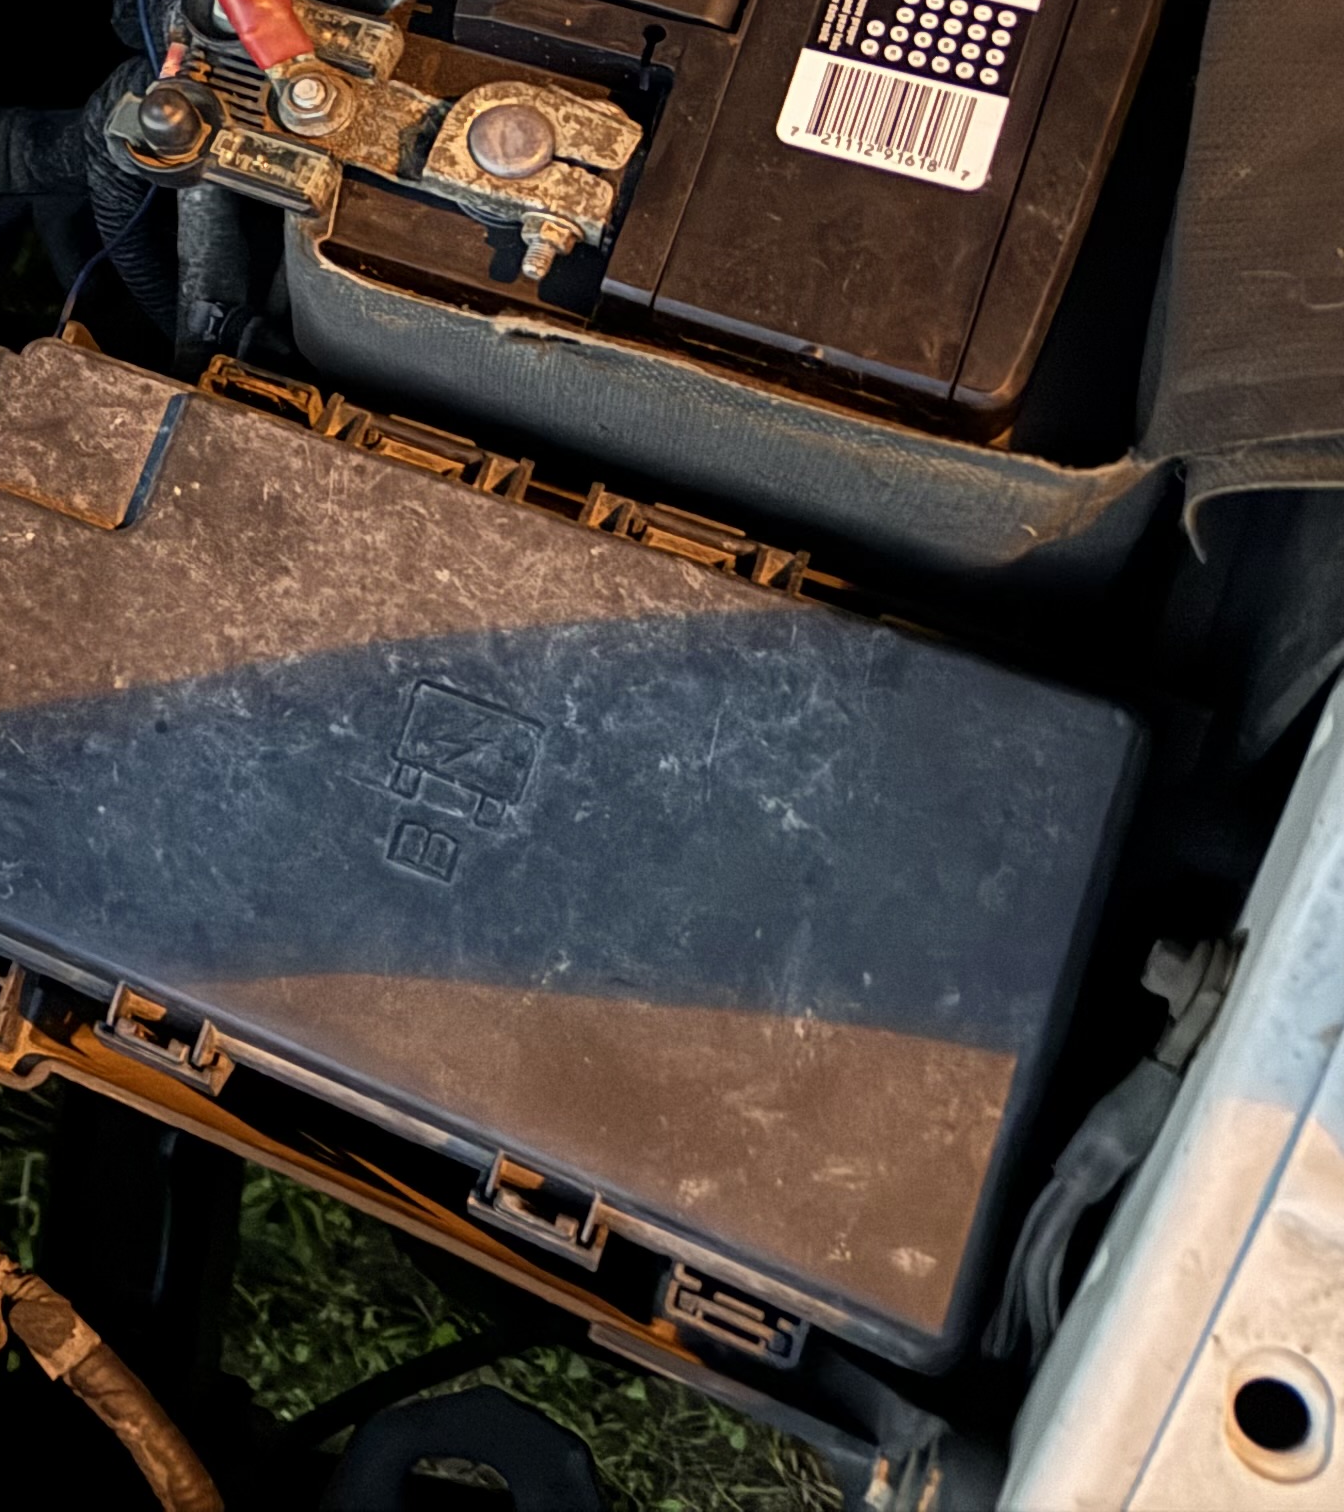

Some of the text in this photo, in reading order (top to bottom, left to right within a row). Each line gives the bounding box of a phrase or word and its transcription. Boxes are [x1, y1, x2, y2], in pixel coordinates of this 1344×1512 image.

[790, 126, 971, 181] 7 21112 91618 7
